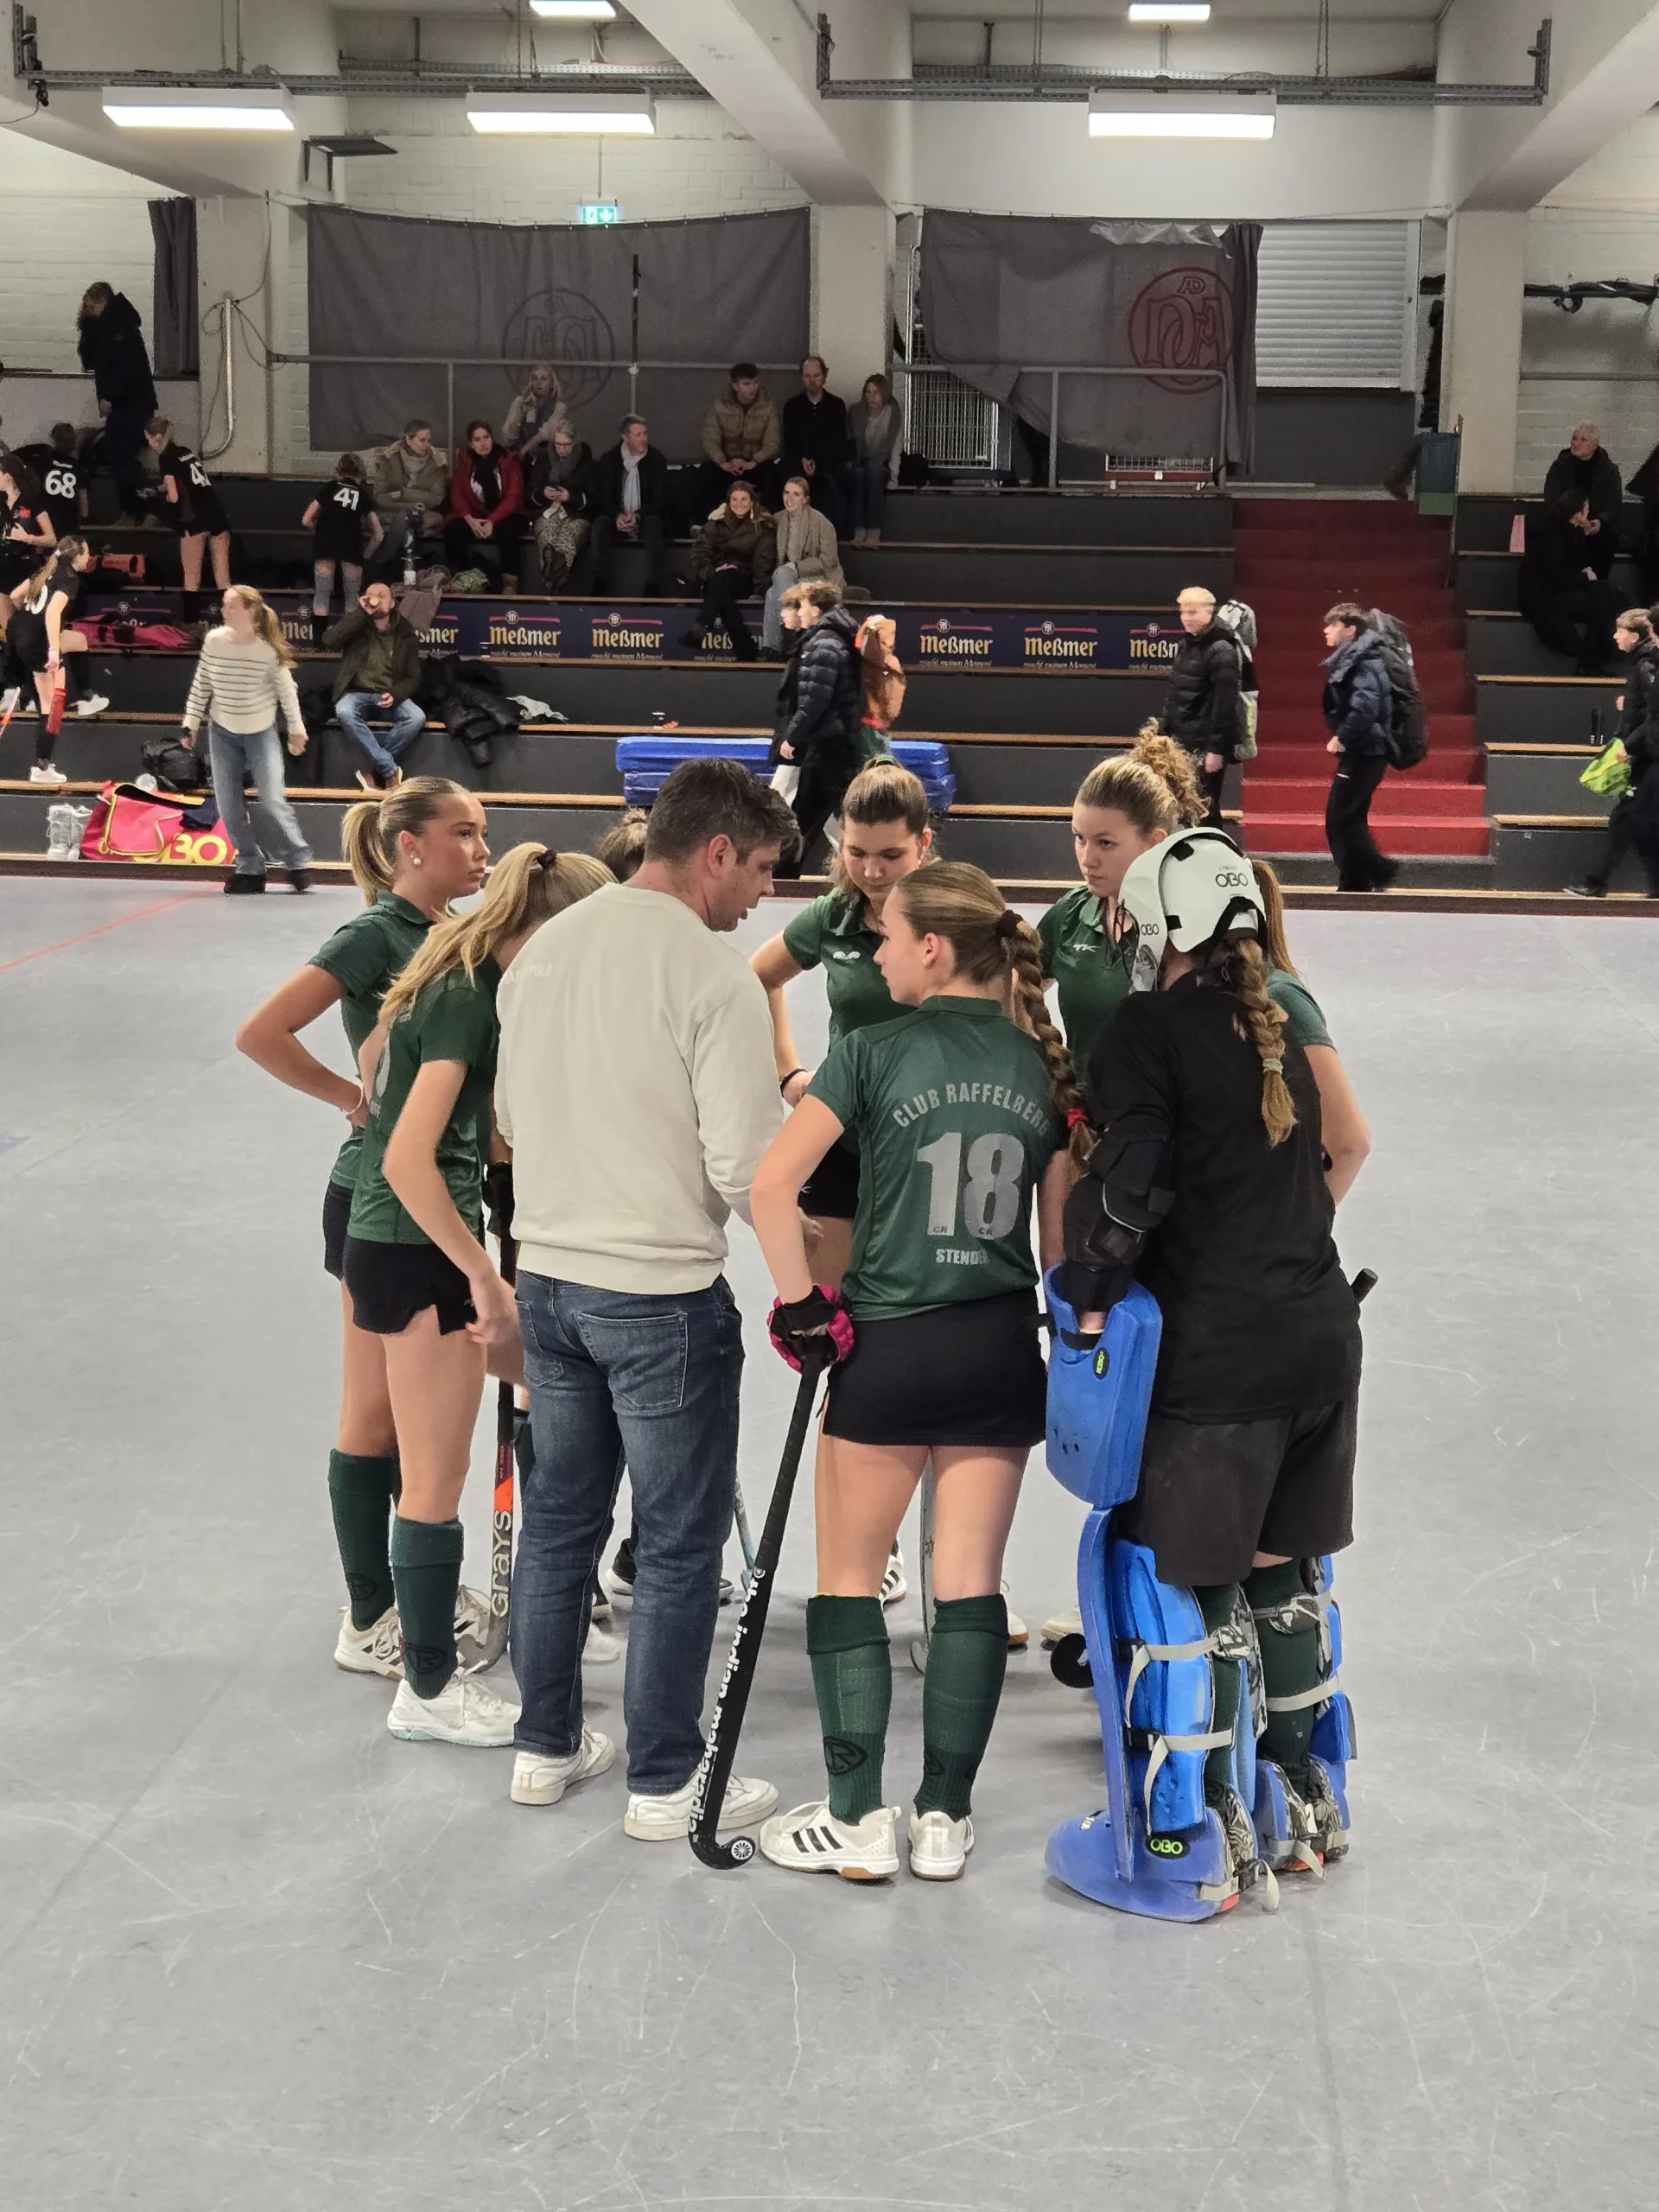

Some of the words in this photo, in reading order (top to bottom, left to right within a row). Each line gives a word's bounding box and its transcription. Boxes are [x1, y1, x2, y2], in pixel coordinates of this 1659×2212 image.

[45, 469, 77, 499] 68
[334, 487, 359, 512] 41
[489, 626, 561, 645] Meßmer
[592, 628, 664, 648] Meßmer
[920, 634, 993, 655] Meßmer
[1024, 637, 1097, 657] Meßmer
[1215, 872, 1249, 888] OBO
[1141, 923, 1160, 936] OBO
[893, 1089, 941, 1128] CLUB
[917, 1132, 1025, 1241] 18
[718, 1624, 748, 1700] indian
[1150, 1839, 1184, 1855] OBO
